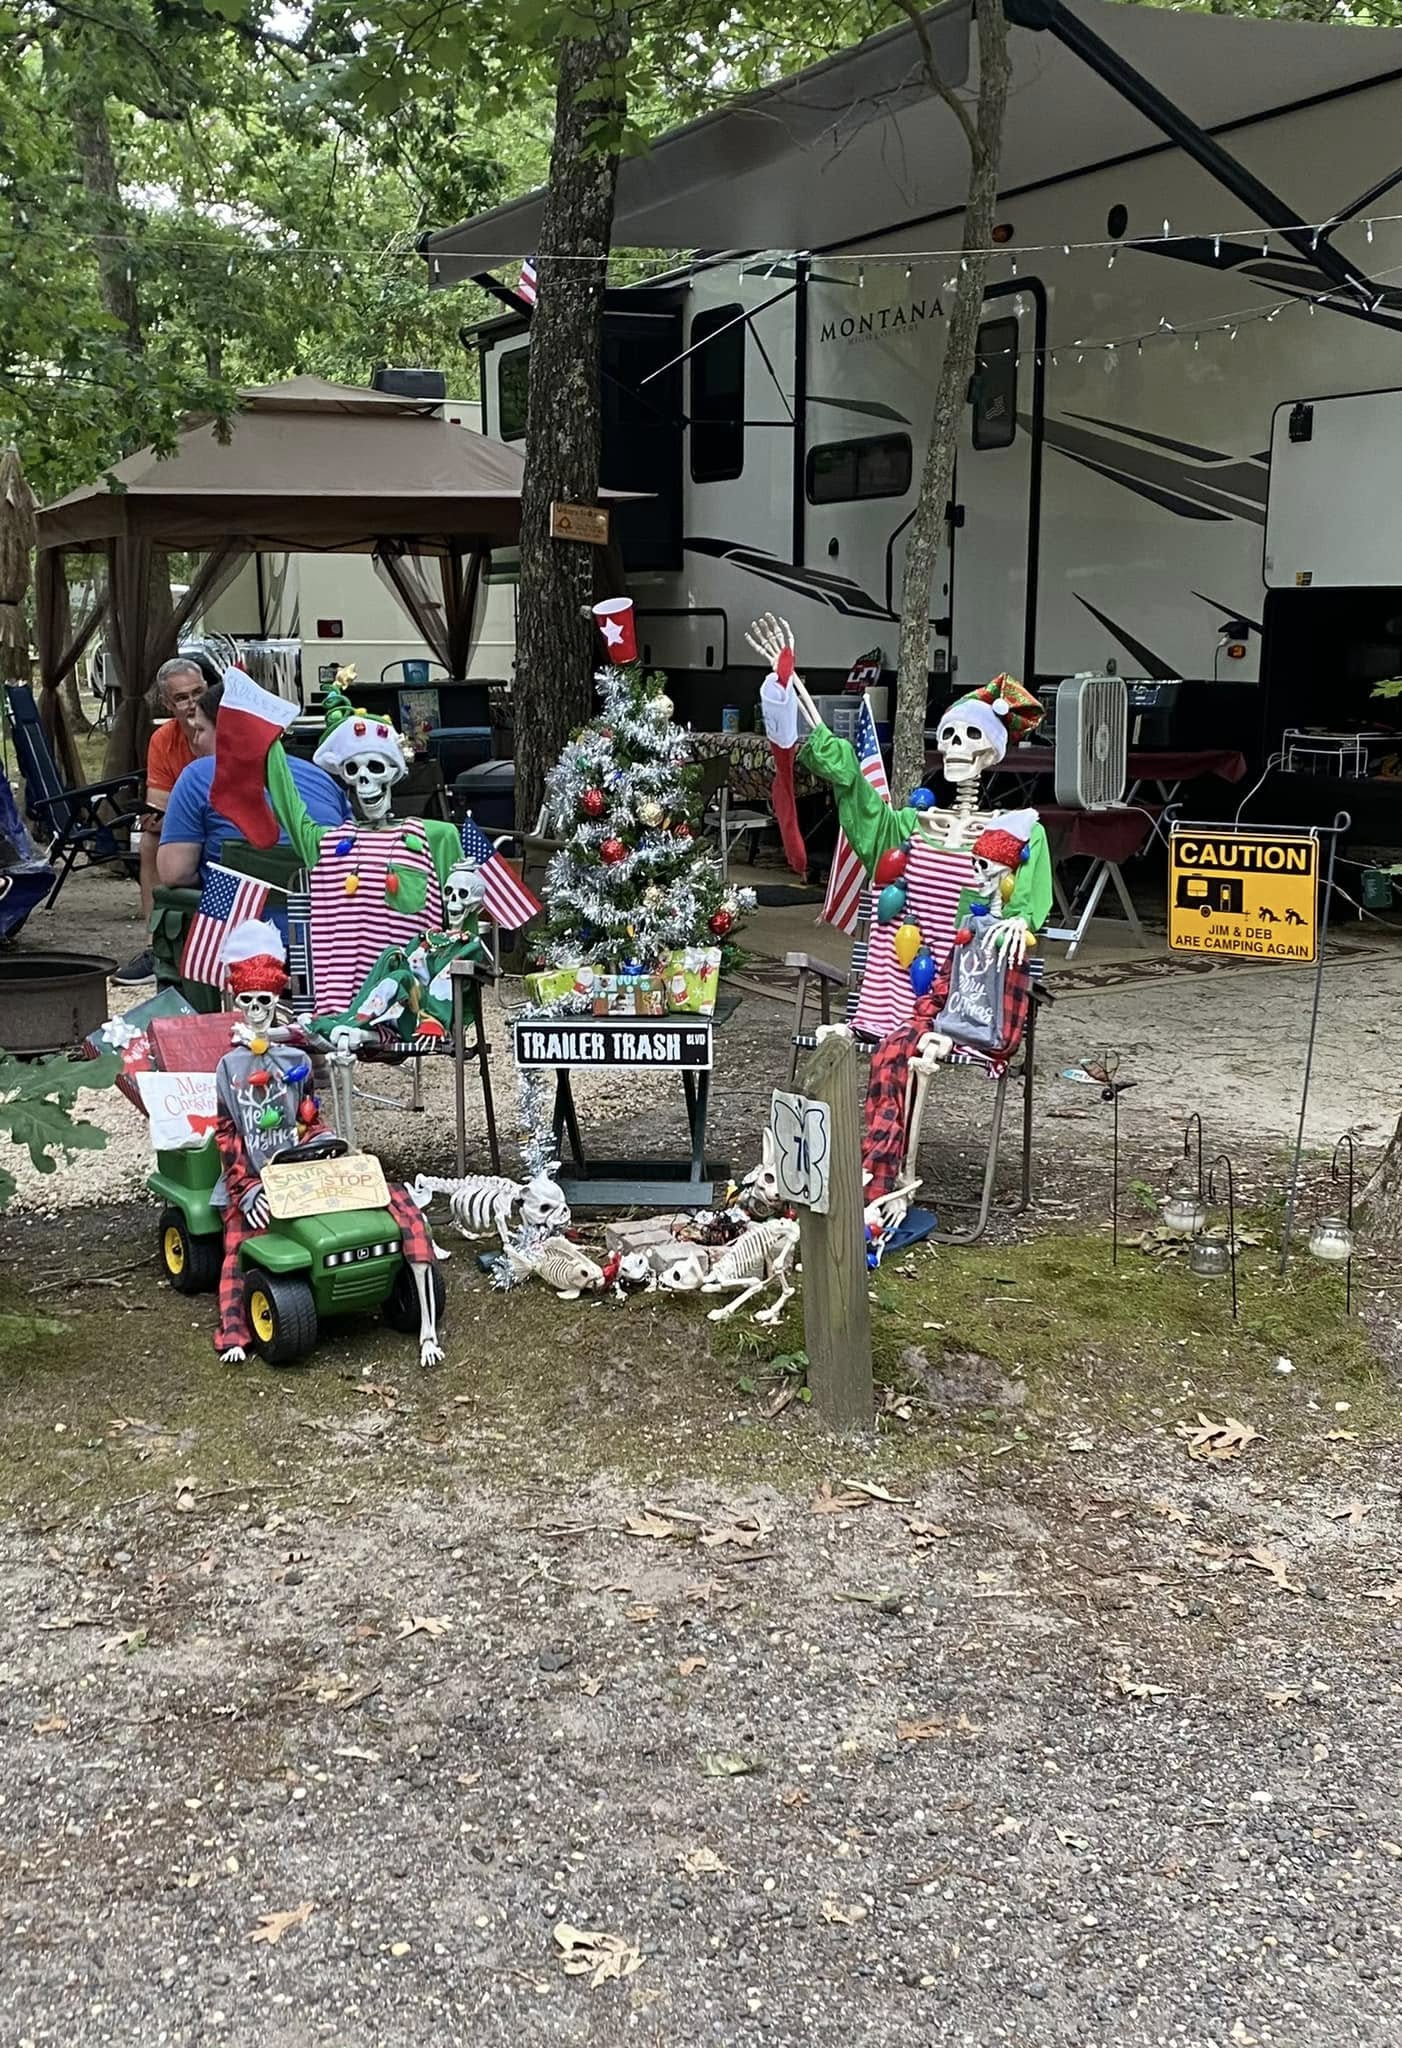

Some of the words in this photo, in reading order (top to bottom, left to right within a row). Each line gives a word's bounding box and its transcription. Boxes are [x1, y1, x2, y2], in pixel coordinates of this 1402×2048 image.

[820, 298, 945, 342] MONTANA
[1179, 842, 1307, 870] CAUTION
[1208, 924, 1229, 936] JIM
[1233, 926, 1241, 937] &
[1246, 927, 1272, 940] DEB
[1175, 935, 1200, 947] ARE
[1204, 937, 1263, 952] CAMPING
[1267, 944, 1309, 958] AGAIN
[521, 1031, 606, 1061] TRAILER
[611, 1032, 681, 1061] TRASH
[686, 1033, 706, 1046] BLVD
[274, 1166, 329, 1187] SANTA
[325, 1174, 372, 1187] STOP
[316, 1187, 353, 1198] HERE
